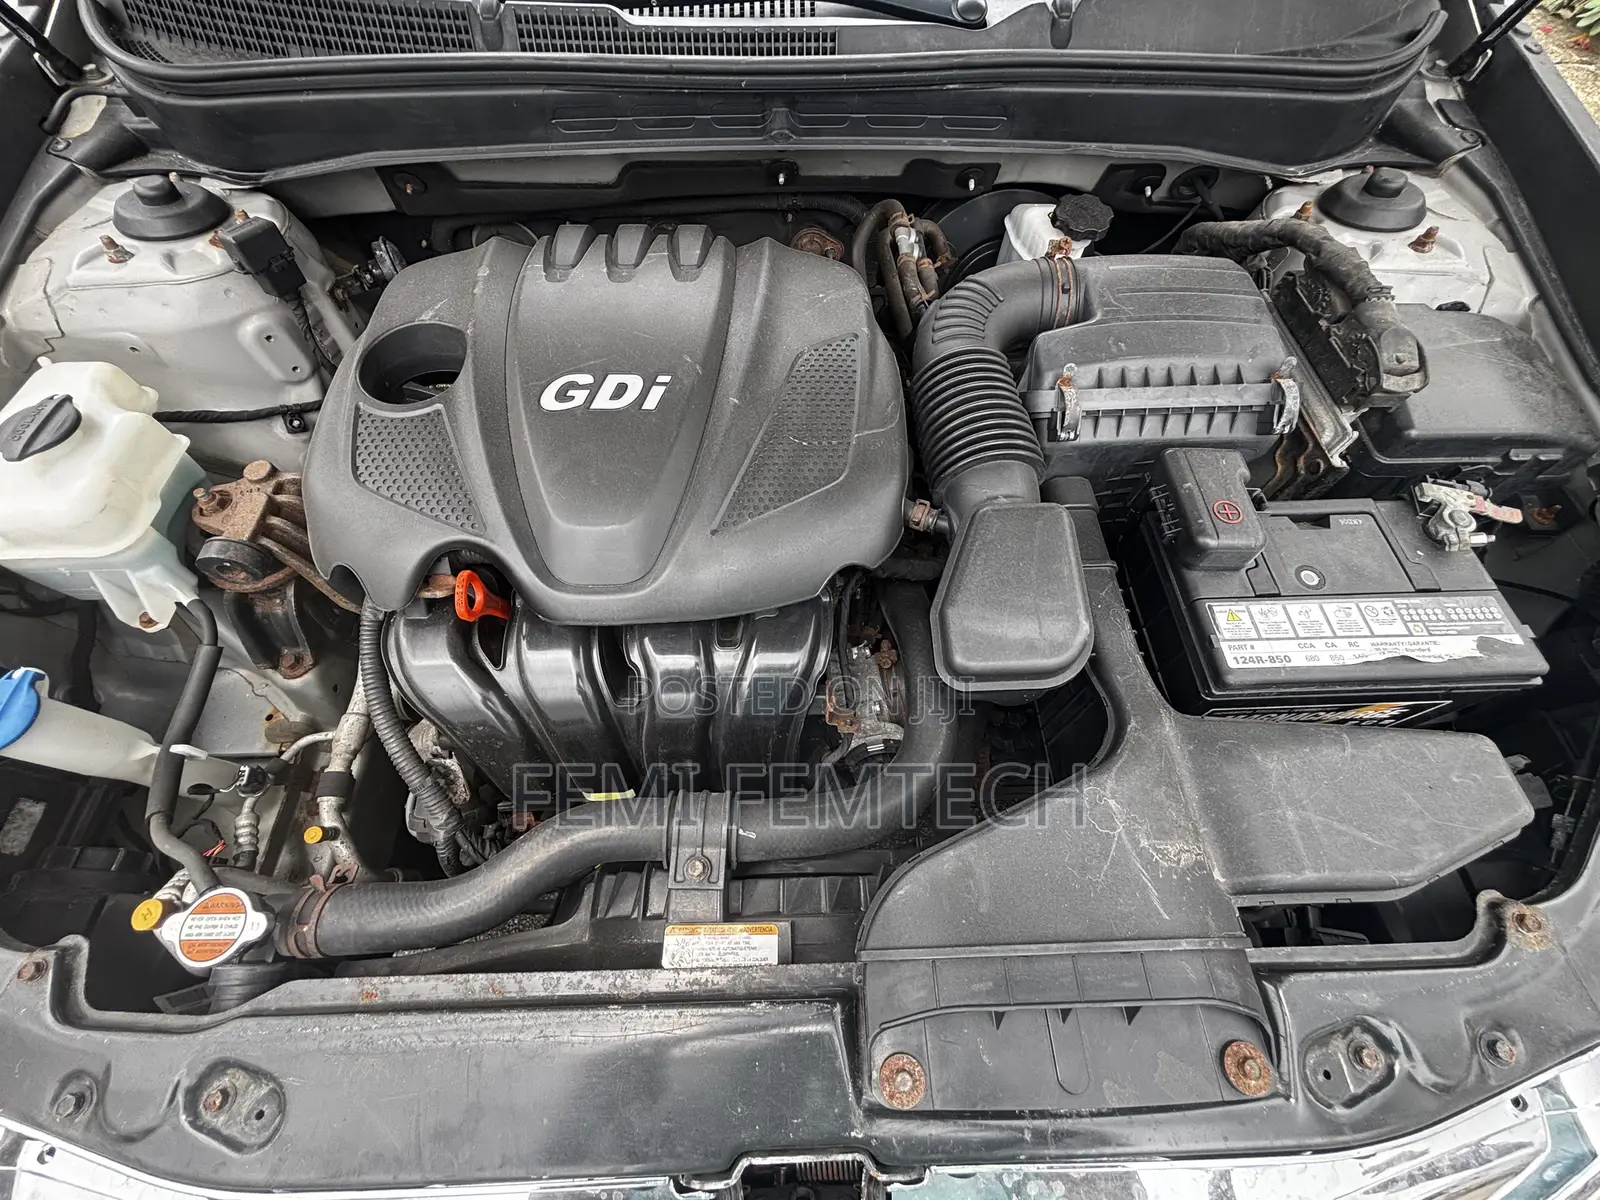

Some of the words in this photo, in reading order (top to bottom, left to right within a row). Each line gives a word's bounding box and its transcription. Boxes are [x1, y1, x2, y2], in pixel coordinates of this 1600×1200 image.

[539, 373, 673, 411] GDi
[1228, 644, 1248, 652] PART
[1325, 641, 1338, 649] CA
[1232, 654, 1292, 665] 124R-850
